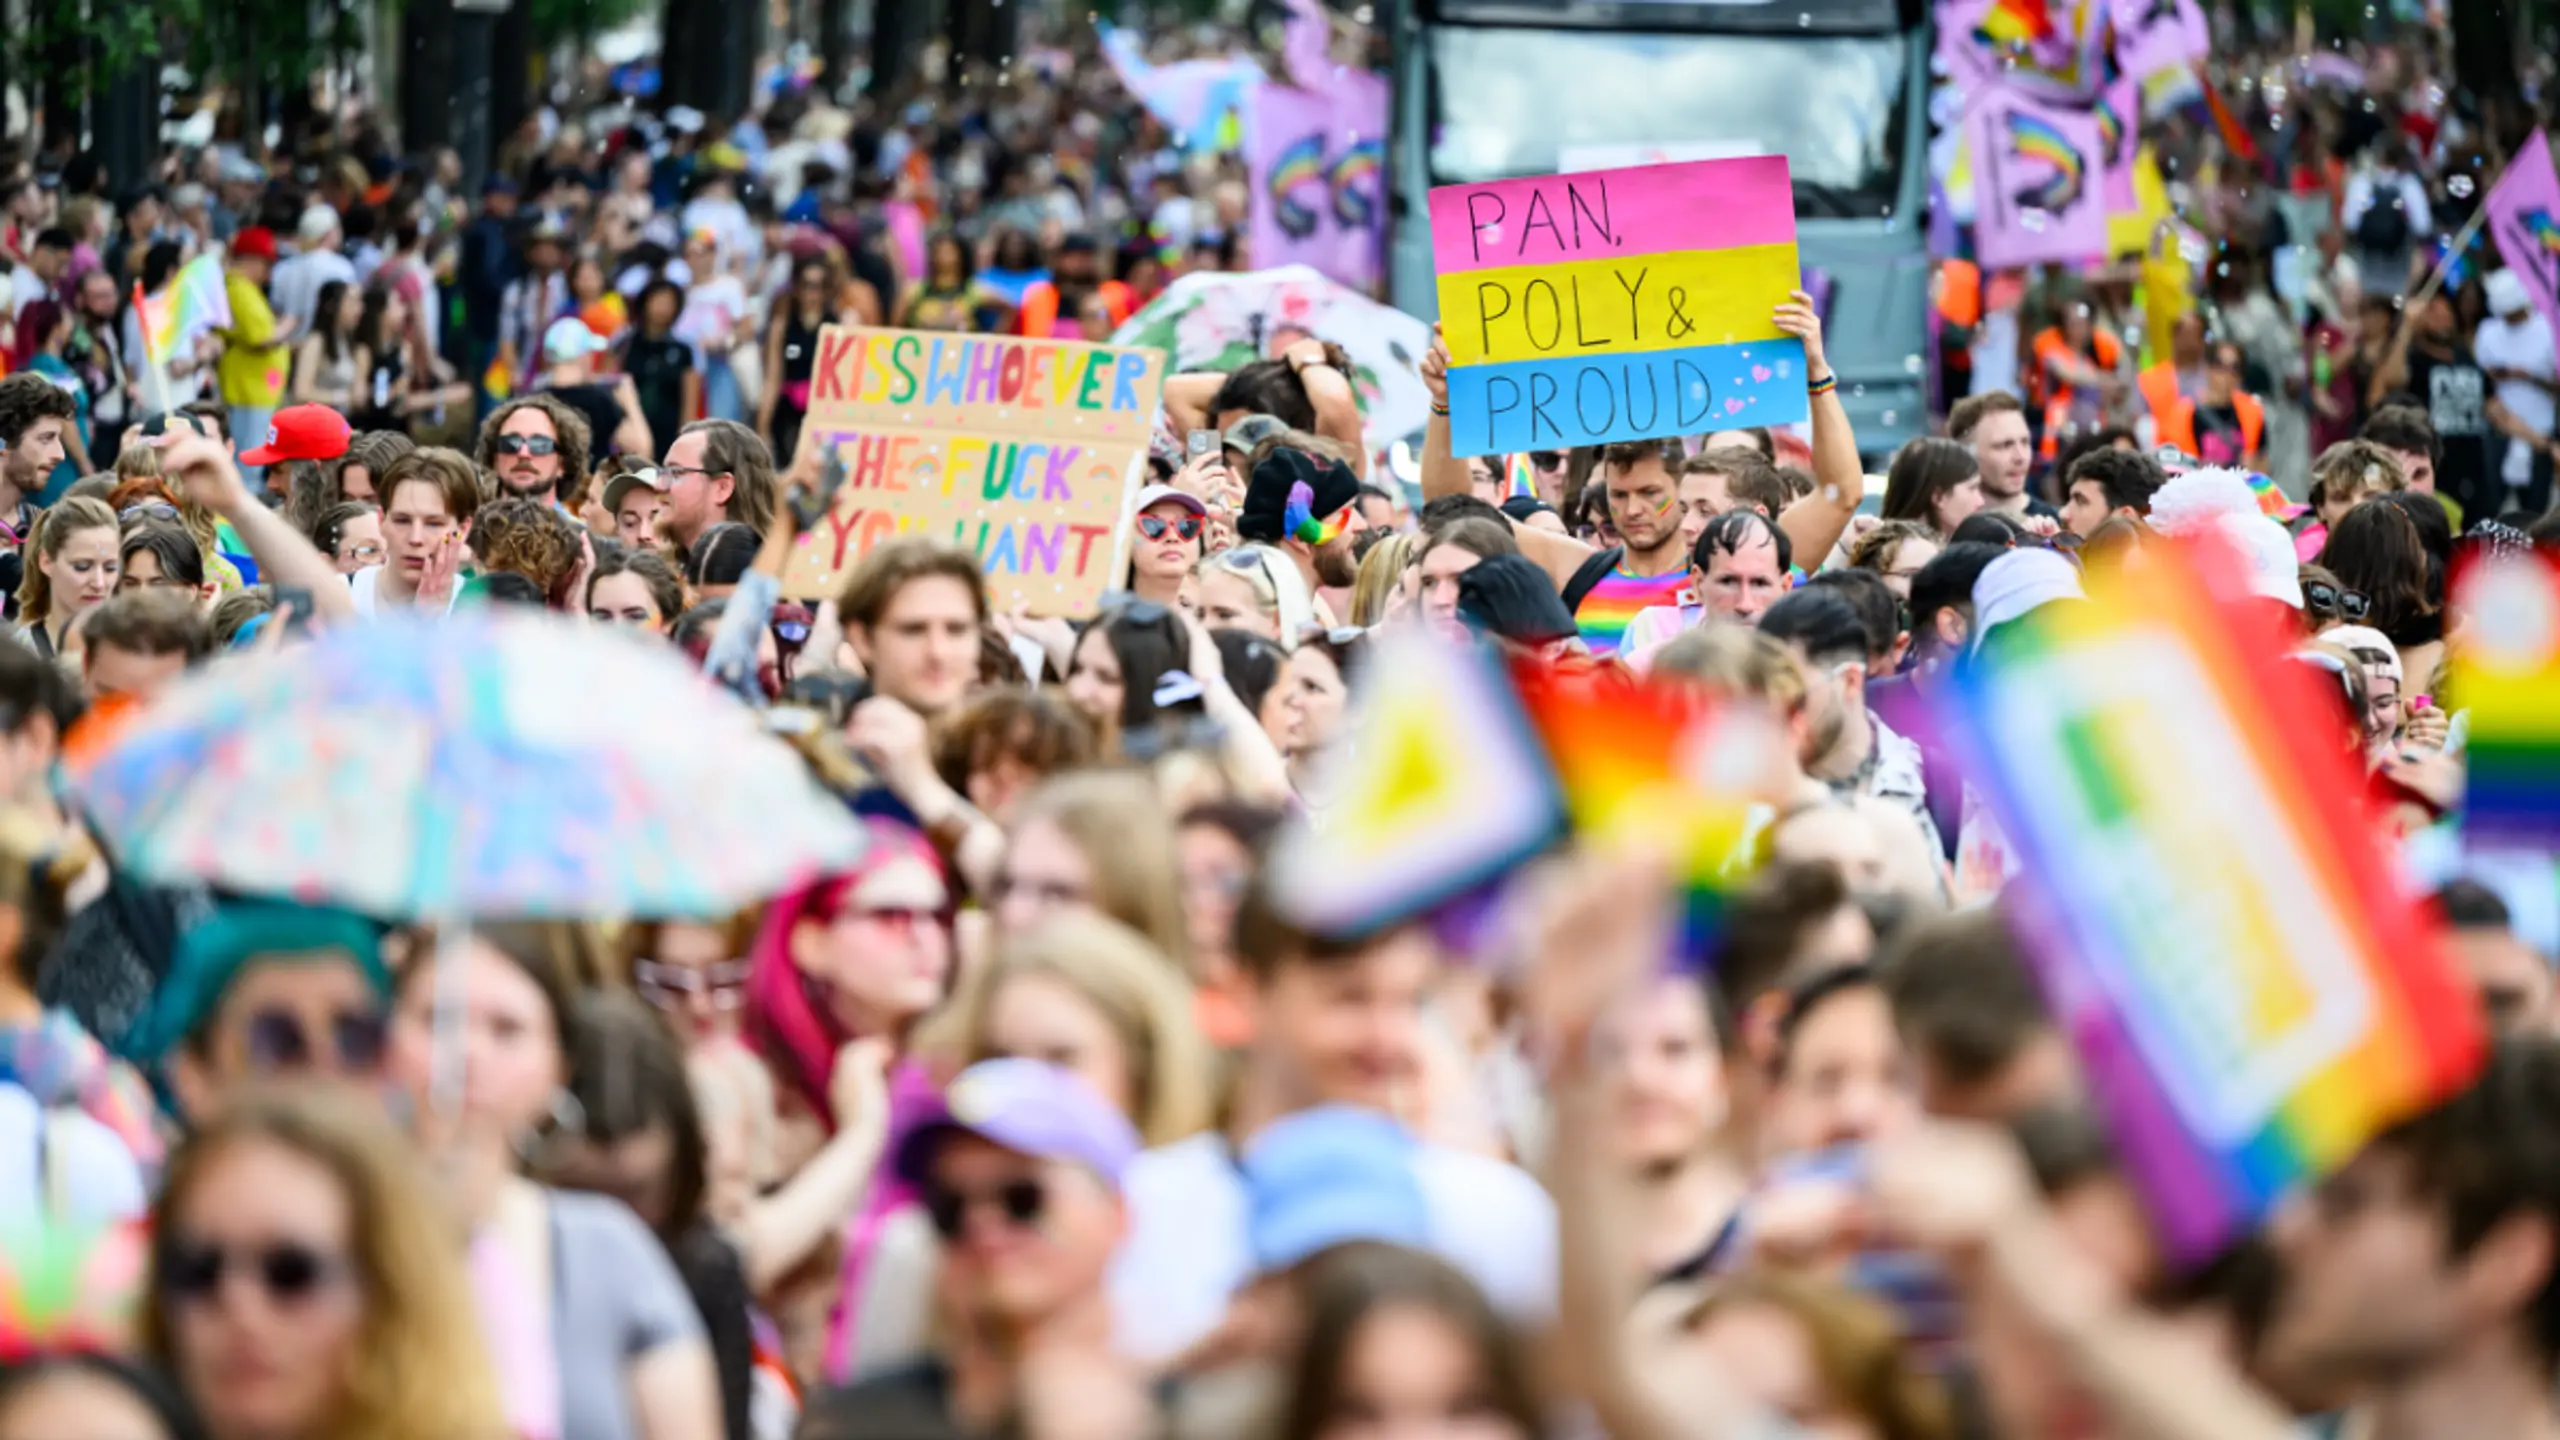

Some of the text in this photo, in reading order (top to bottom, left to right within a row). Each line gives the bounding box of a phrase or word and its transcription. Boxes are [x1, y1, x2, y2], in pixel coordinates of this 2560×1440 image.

[1477, 267, 1696, 355] POLY &
[815, 333, 1147, 412] KISS WHOEVER
[1486, 359, 1712, 449] PROUD
[940, 436, 1083, 501] FUCK
[828, 507, 928, 571] YO
